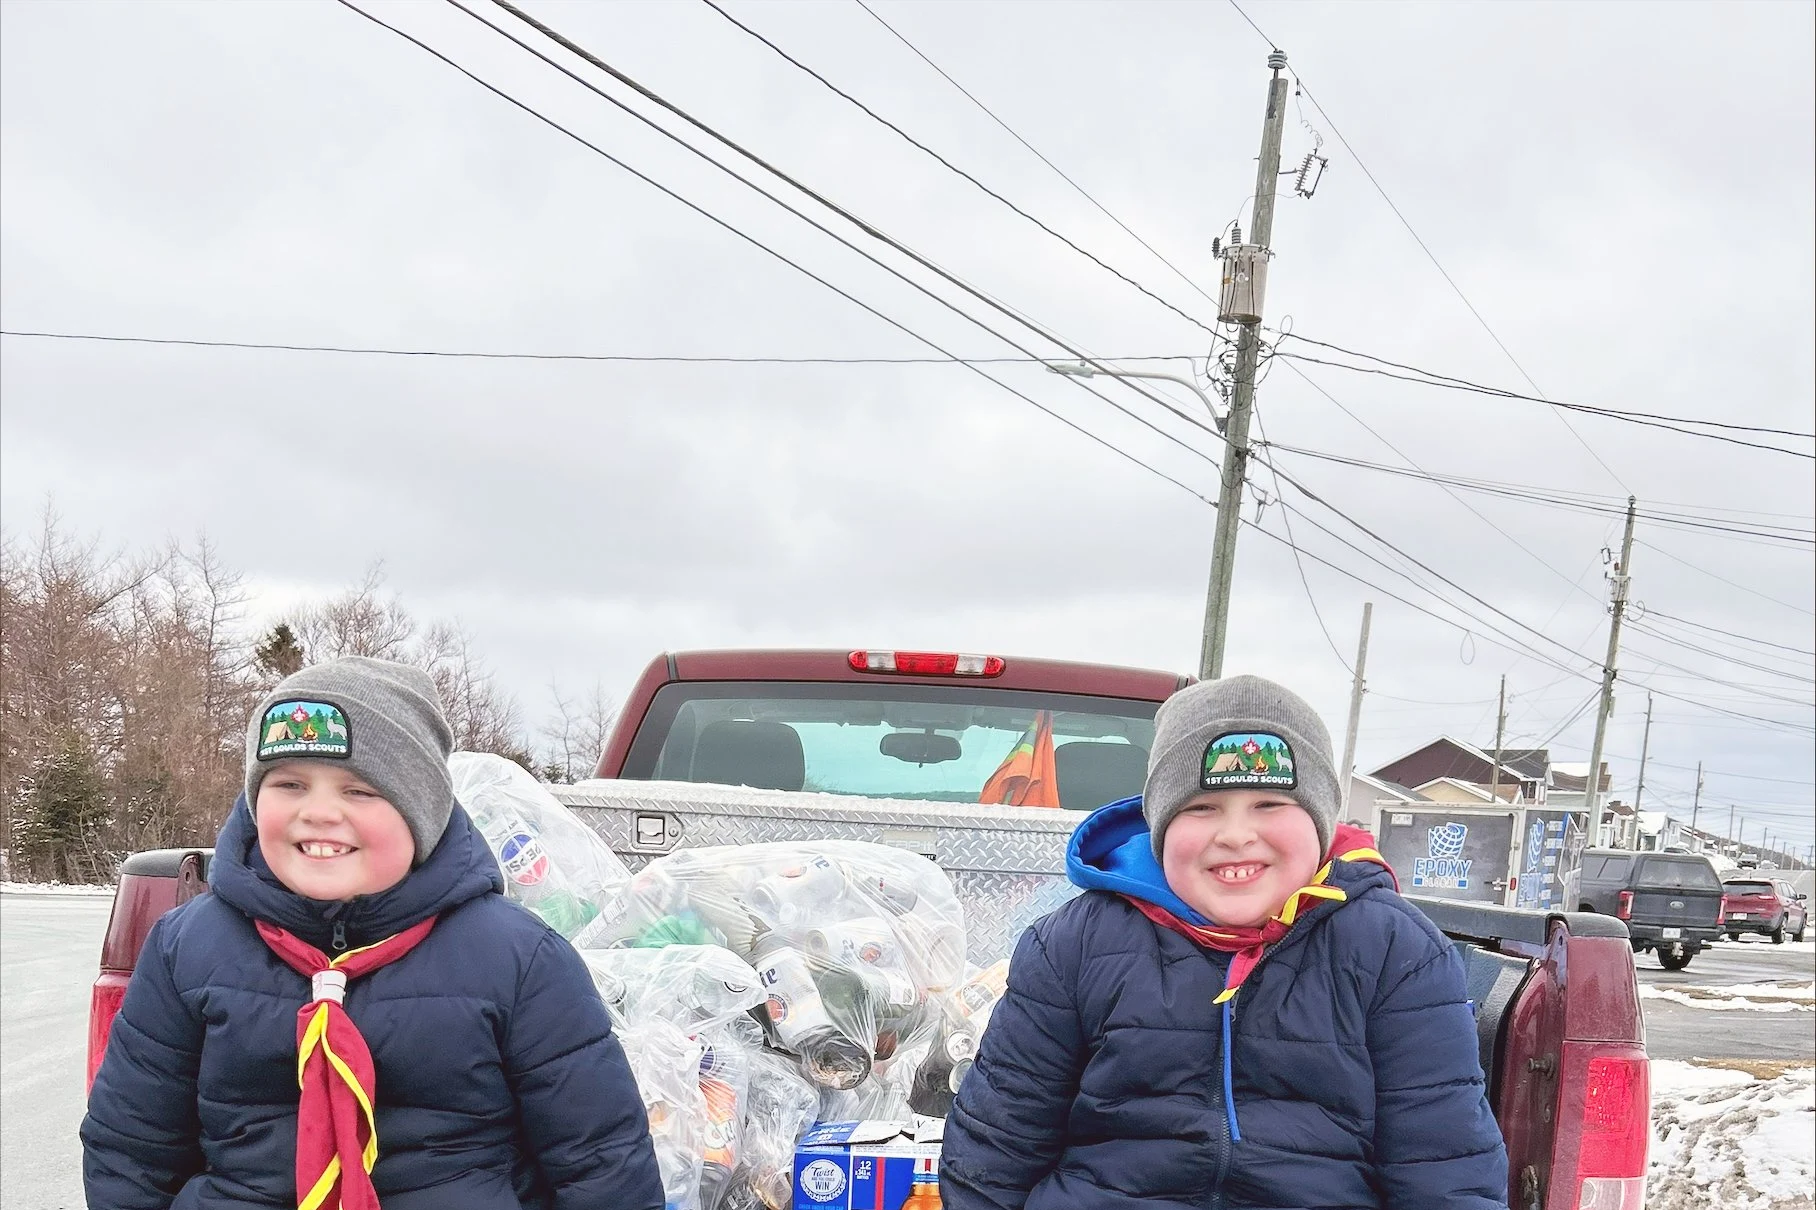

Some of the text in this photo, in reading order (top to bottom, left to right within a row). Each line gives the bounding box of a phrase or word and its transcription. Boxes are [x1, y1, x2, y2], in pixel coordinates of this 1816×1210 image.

[273, 743, 307, 753] GOULDS
[308, 743, 347, 753] SCOUTS
[1205, 775, 1294, 785] 1ST GOULDS SCOUTS
[505, 843, 542, 875] PEPSI
[1414, 857, 1472, 879] EPOXY
[860, 1160, 872, 1170] 12
[811, 1166, 835, 1177] Twist
[815, 1181, 830, 1191] WIN
